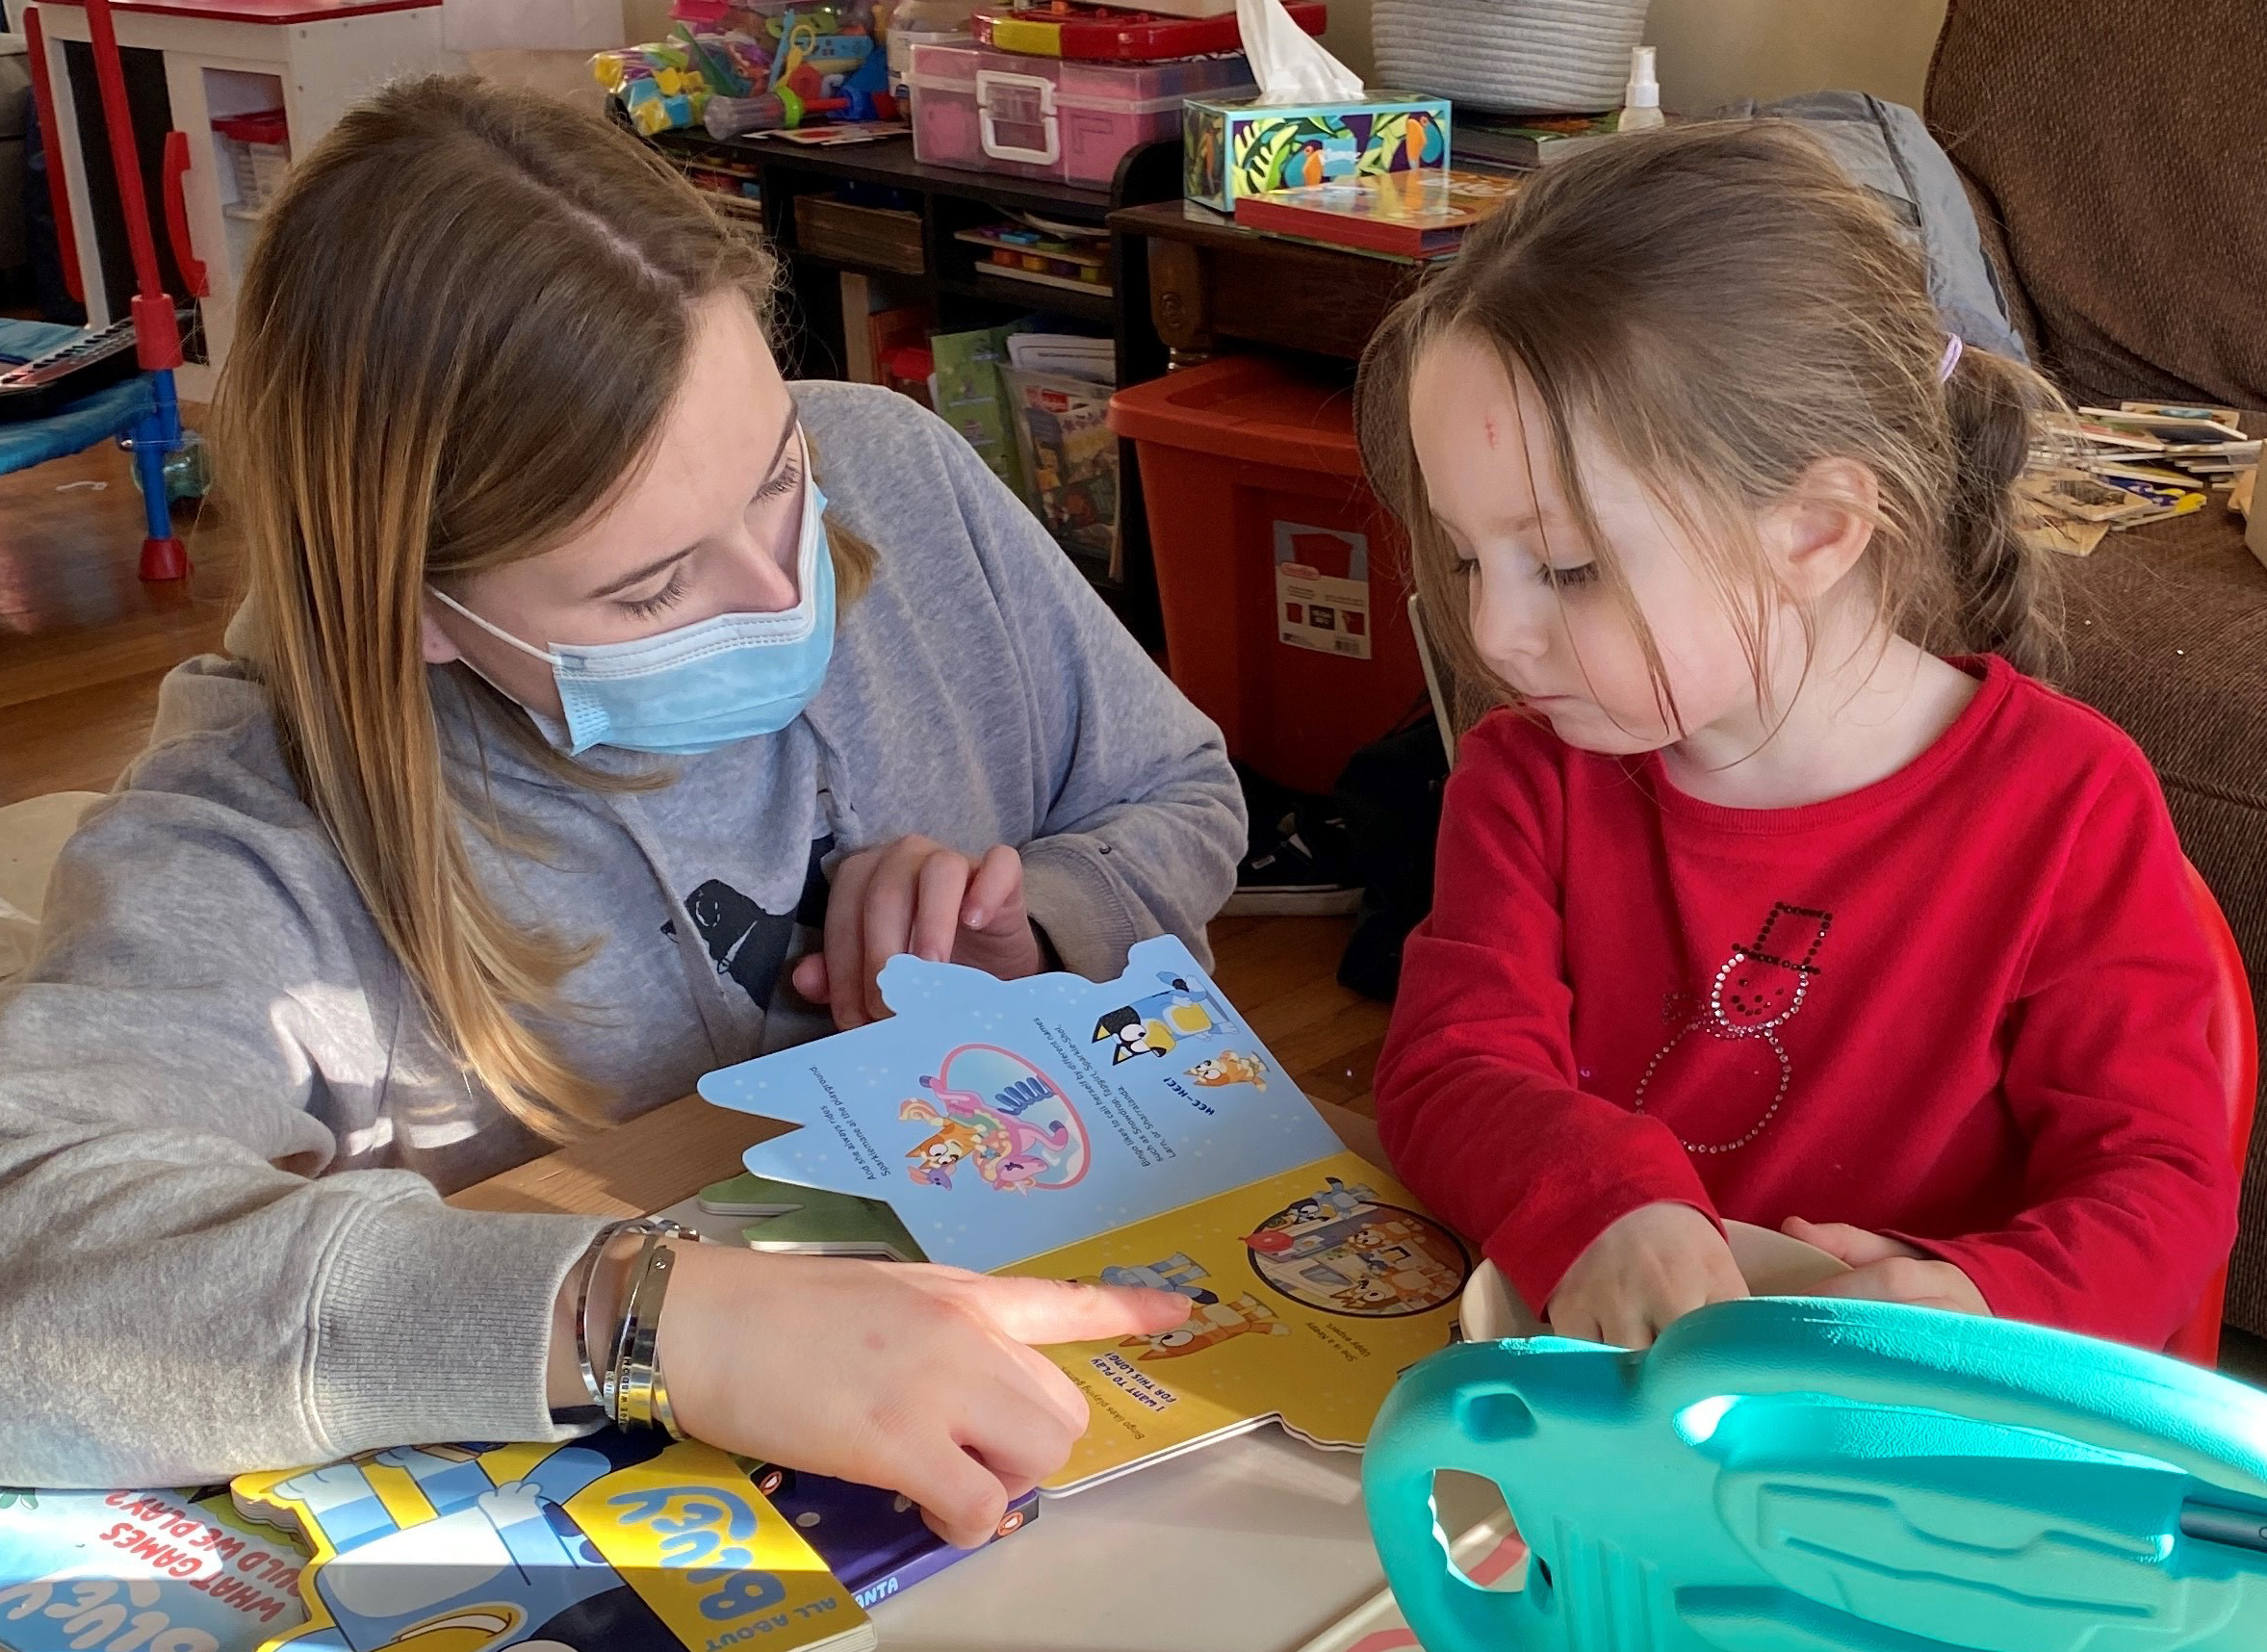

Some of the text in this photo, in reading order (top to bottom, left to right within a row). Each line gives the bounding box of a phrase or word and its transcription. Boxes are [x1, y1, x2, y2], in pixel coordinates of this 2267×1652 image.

[1032, 1017, 1053, 1041] names
[818, 1104, 837, 1124] rides
[833, 1124, 856, 1151] always
[1117, 1126, 1134, 1147] likes
[1130, 1145, 1151, 1168] Bingo
[1146, 1144, 1163, 1163] such
[861, 1165, 876, 1180] And
[1091, 1356, 1116, 1377] PLAY
[1132, 1372, 1155, 1391] THIS
[1124, 1384, 1157, 1409] WANT
[1153, 1386, 1176, 1405] FOR
[191, 1528, 245, 1562] WE
[607, 1485, 786, 1620] BLUEY
[99, 1522, 285, 1623] WHAT GAMES
[855, 1576, 899, 1609] ANTA
[706, 1596, 837, 1652] ALL ABOUT
